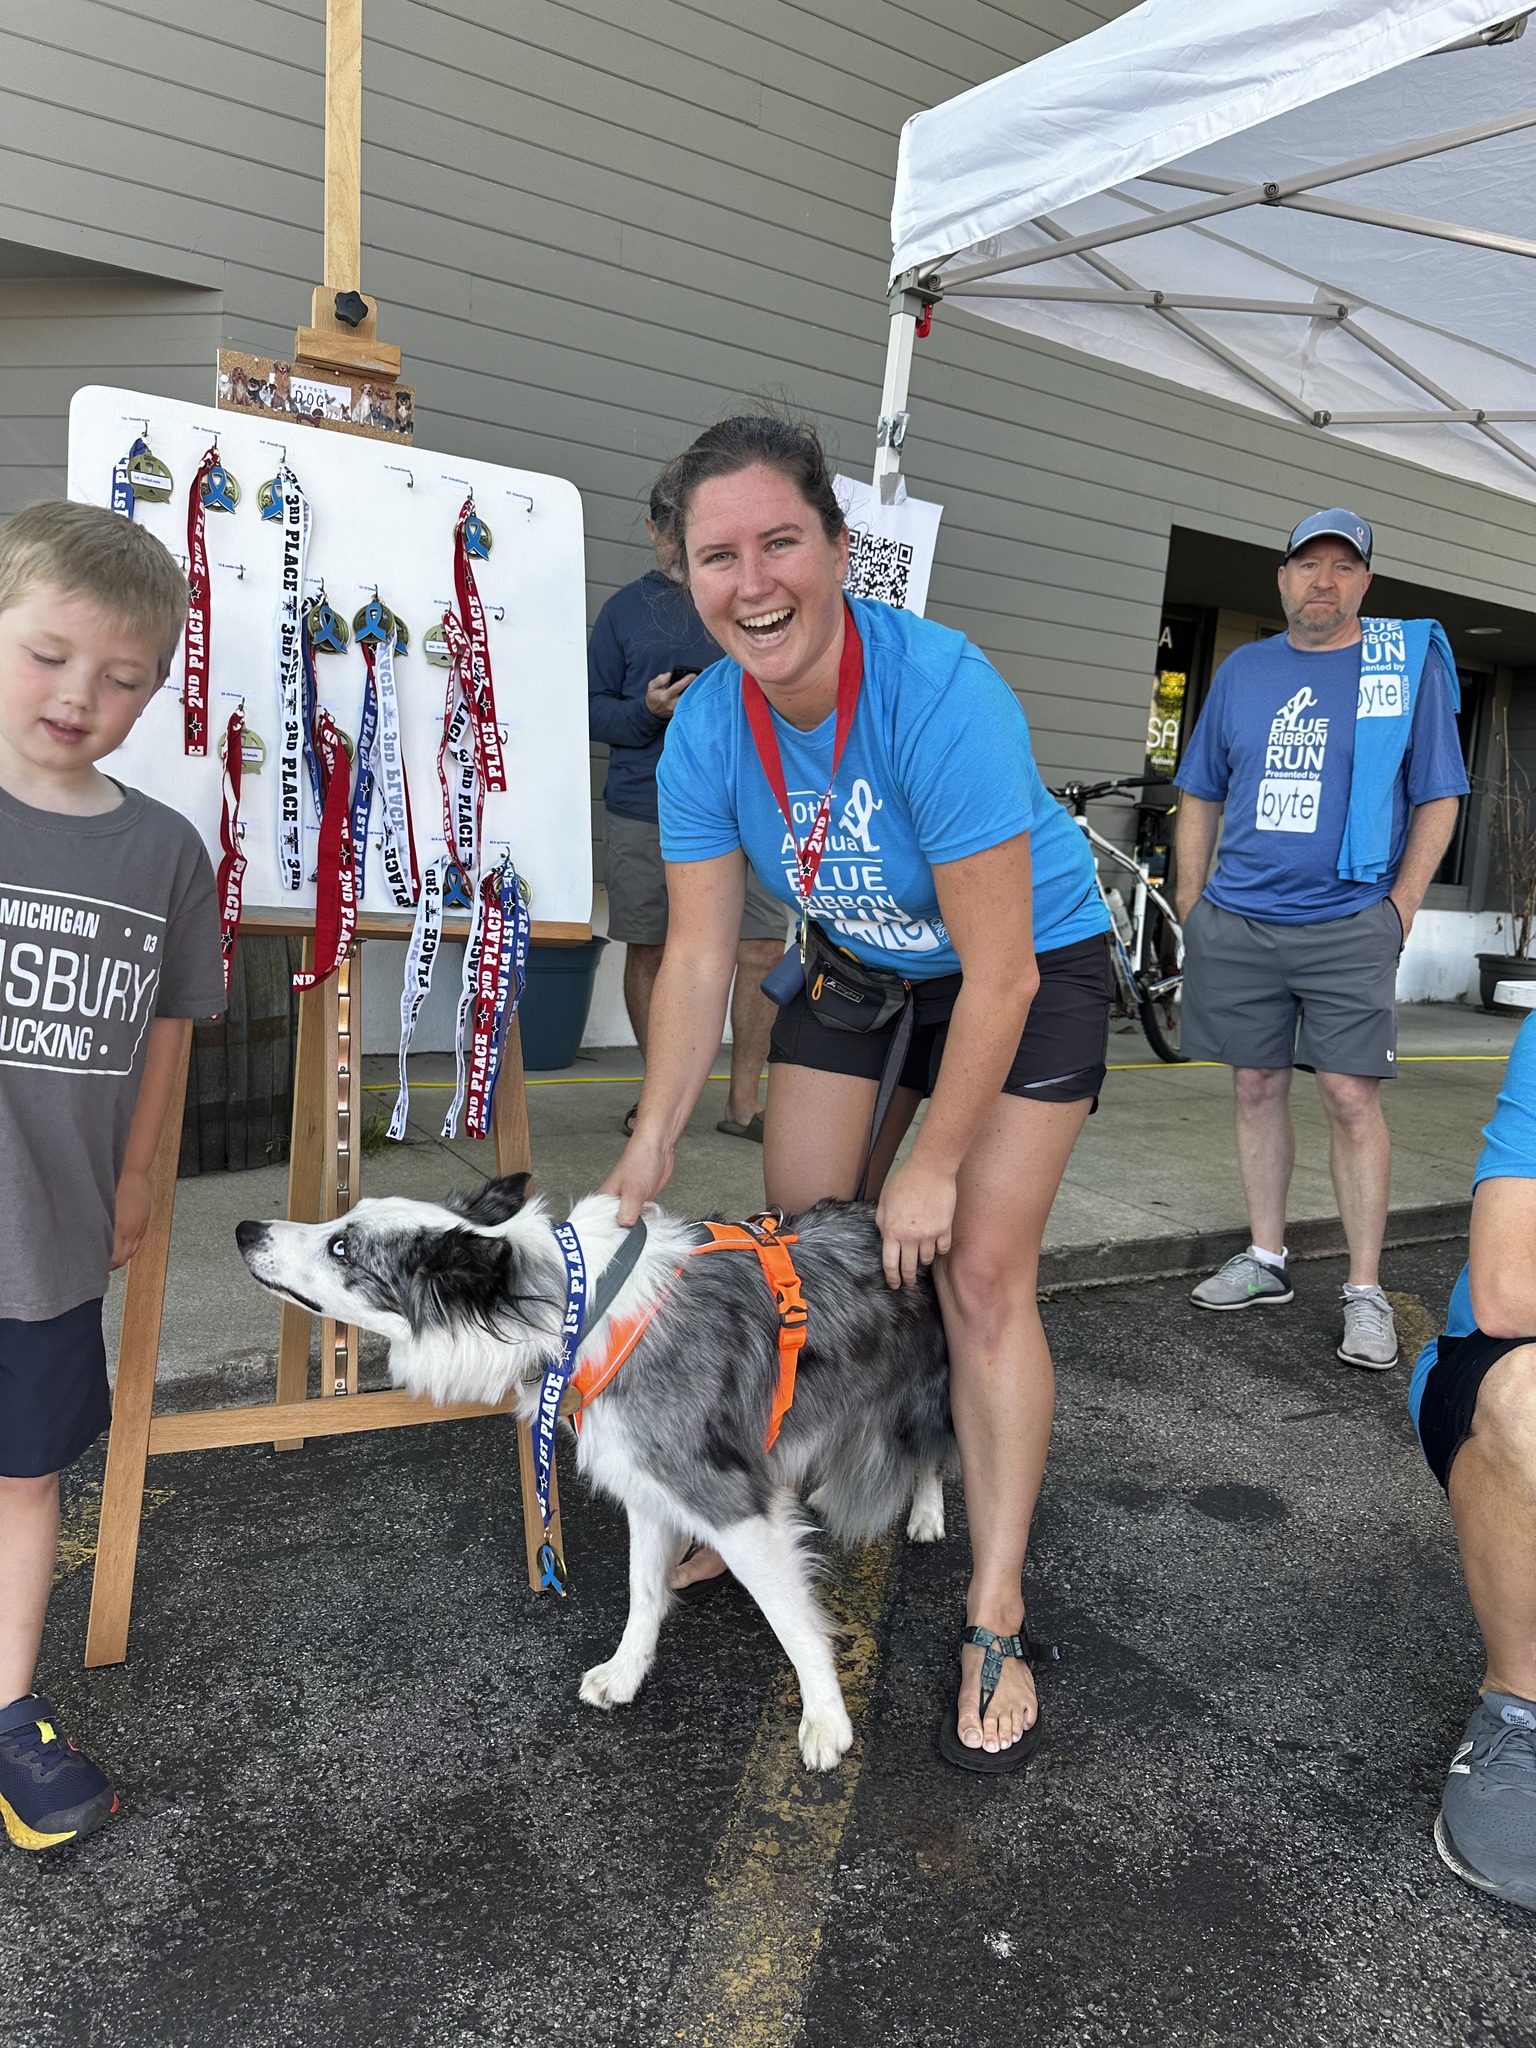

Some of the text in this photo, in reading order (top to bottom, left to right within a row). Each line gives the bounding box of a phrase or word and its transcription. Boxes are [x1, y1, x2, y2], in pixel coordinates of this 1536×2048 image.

[295, 390, 325, 408] DOG
[193, 542, 205, 576] 2ND
[283, 495, 300, 592] 3RD PLACE
[281, 623, 296, 657] 3RD
[468, 595, 487, 653] PLACE
[1159, 626, 1173, 649] A
[188, 608, 204, 709] 2ND PLACE
[460, 648, 471, 680] 2ND
[1394, 663, 1405, 672] by
[1268, 732, 1328, 746] RIBBON
[1270, 718, 1330, 733] BLUE
[480, 722, 503, 778] PLACE
[1265, 746, 1326, 771] RUN
[282, 720, 299, 822] 3RD PLACE
[1265, 770, 1320, 781] Presented by
[355, 807, 368, 836] 1ST
[459, 793, 474, 848] PLACE
[1262, 784, 1315, 827] byte
[807, 816, 828, 854] 2ND
[223, 860, 247, 922] PLACE
[287, 858, 300, 891] 3RD
[385, 848, 409, 907] PLACE
[425, 868, 440, 896] 3RD
[0, 898, 100, 939] MICHIGAN
[333, 871, 356, 967] 2ND PLACE
[795, 894, 901, 910] RIBBON
[143, 933, 158, 954] 03
[503, 919, 515, 948] 1ST
[417, 928, 438, 989] PLACE
[467, 935, 484, 995] PLACE
[482, 907, 503, 1000] 2ND PLACE
[516, 939, 525, 968] 1ST
[0, 939, 156, 1023] SBURY
[494, 952, 512, 1012] PLACE
[488, 1047, 498, 1075] 1ST
[467, 1033, 488, 1129] 2ND PLACE
[555, 1226, 584, 1335] 1ST PLACE
[539, 1371, 565, 1440] PLACE
[538, 1438, 551, 1471] 1ST
